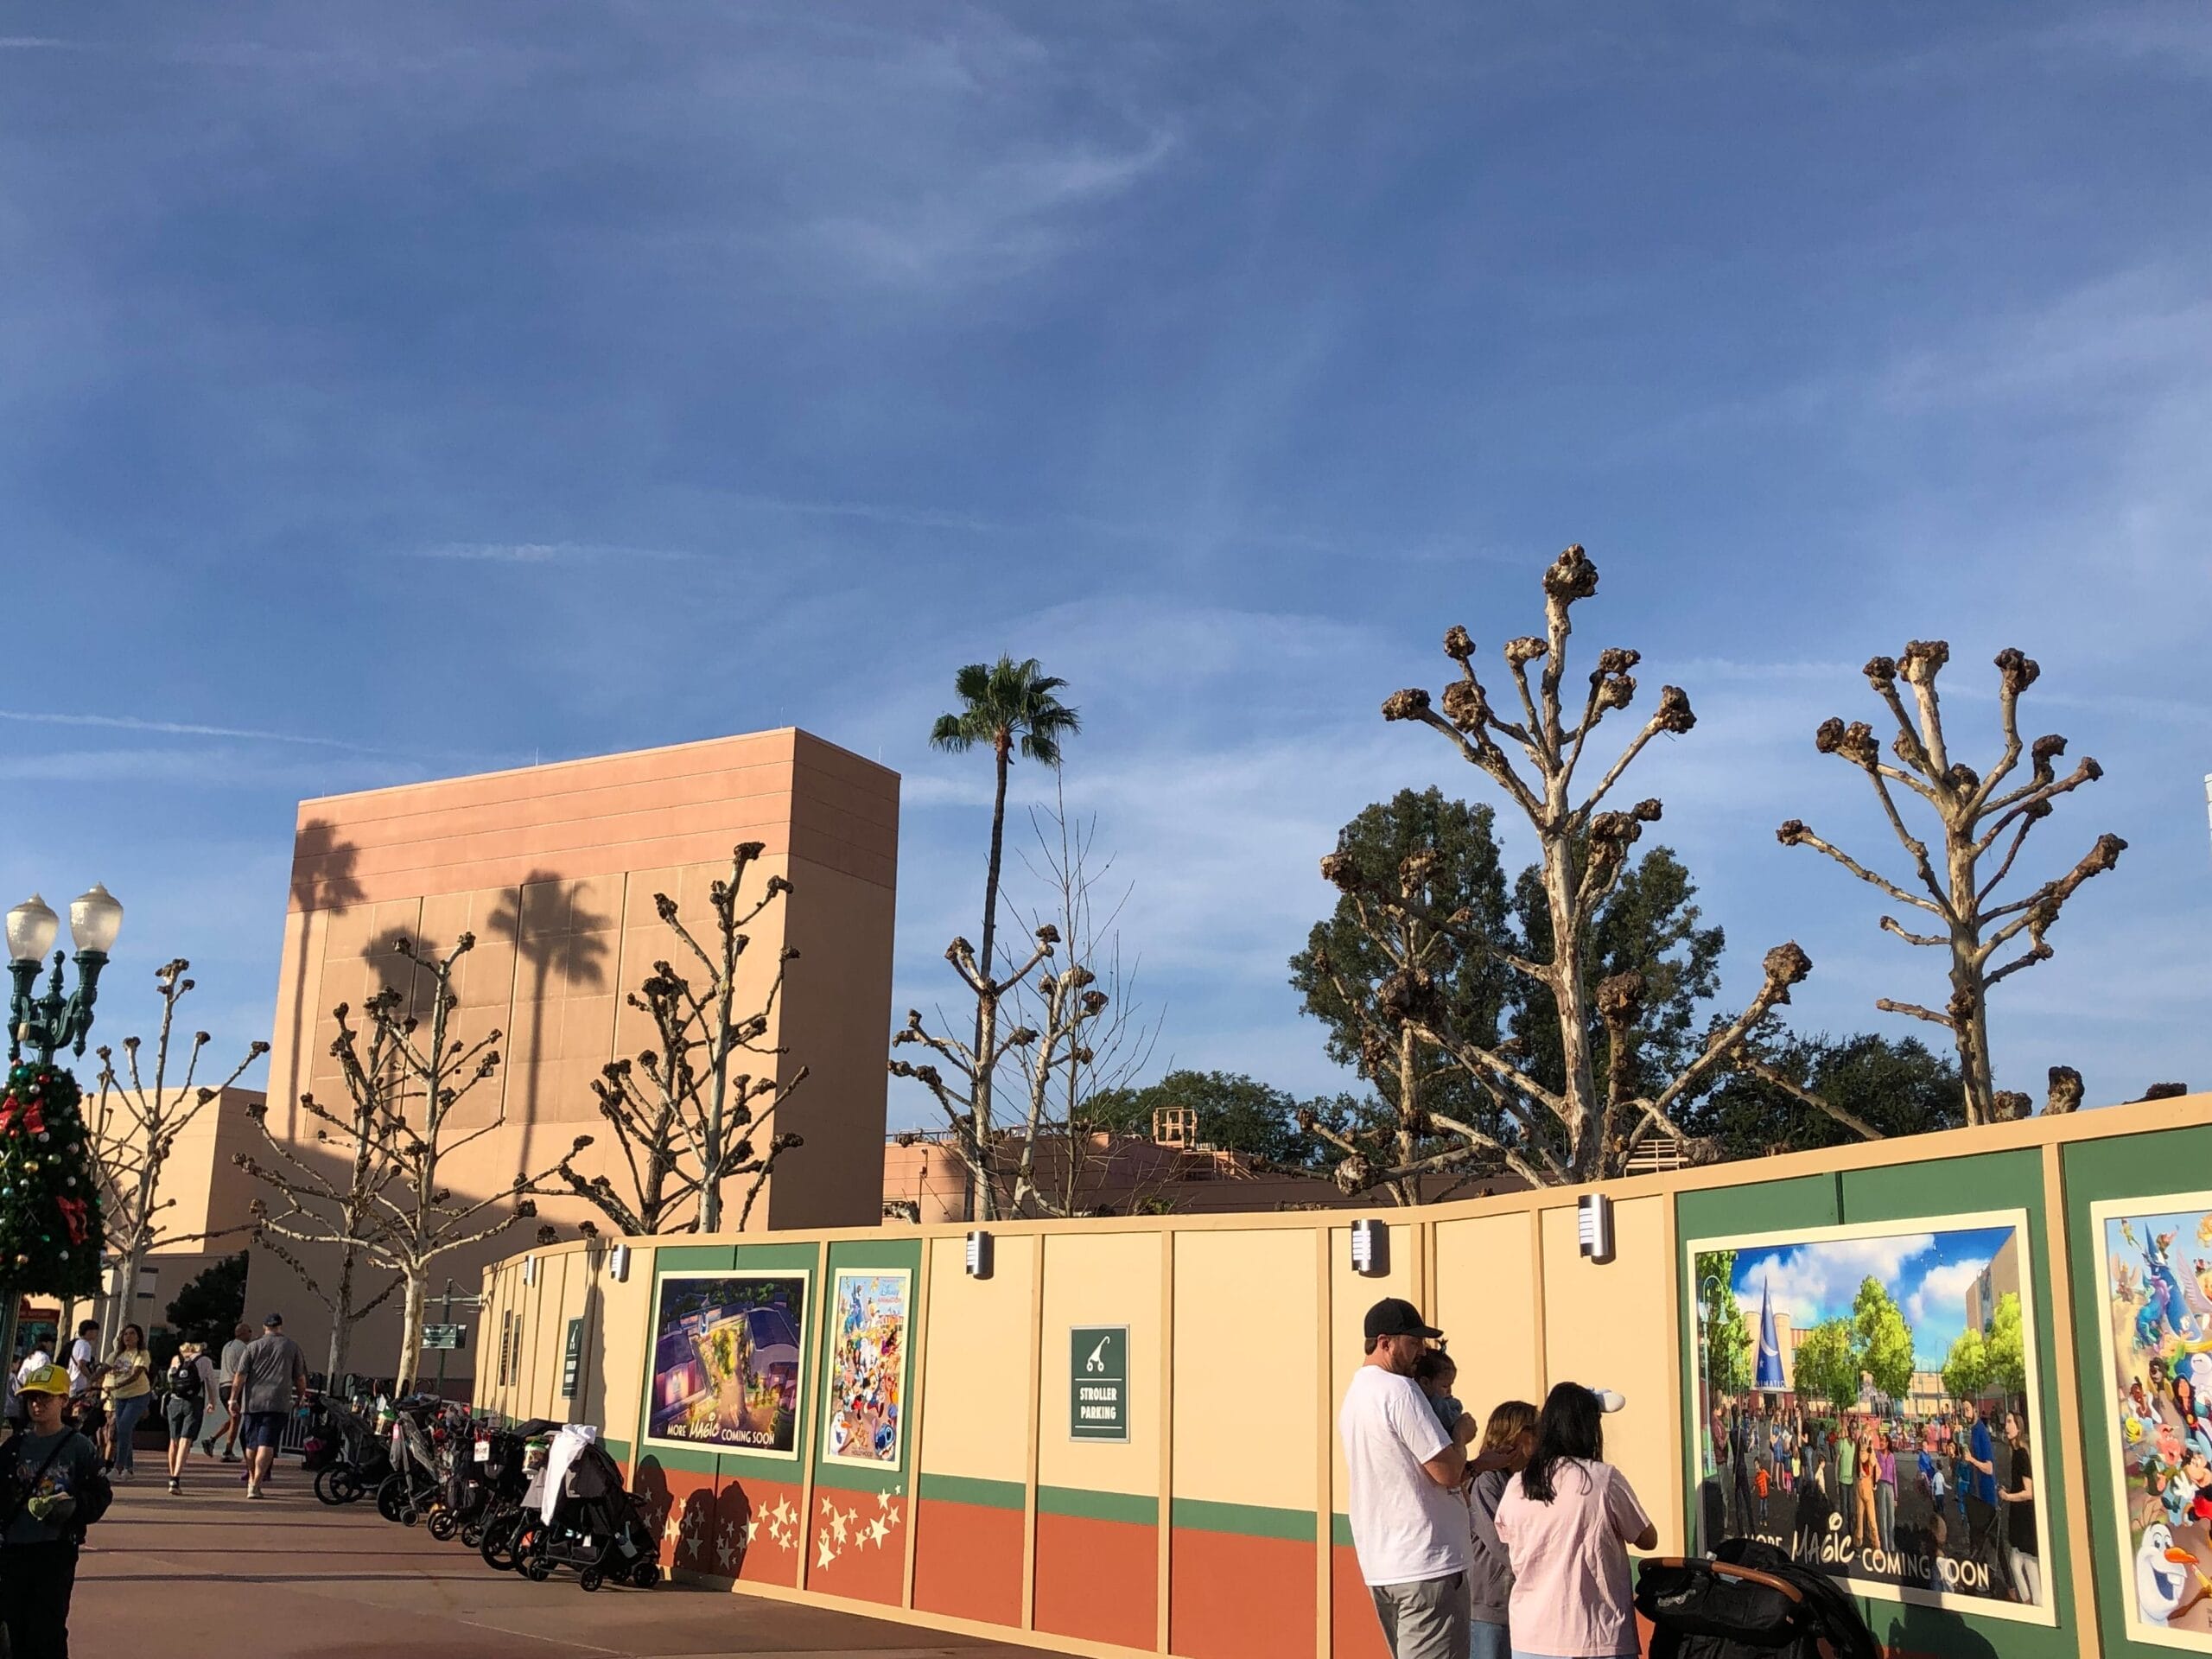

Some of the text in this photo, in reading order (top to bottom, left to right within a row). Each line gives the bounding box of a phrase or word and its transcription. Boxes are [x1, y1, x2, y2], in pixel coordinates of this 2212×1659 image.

[1080, 1387, 1117, 1401] STROLLER
[1081, 1406, 1116, 1420] PARKING
[667, 1412, 775, 1445] MORE MAGIC COMING SOON
[1791, 1512, 1855, 1566] MAGIC
[1862, 1548, 1931, 1580] COMING
